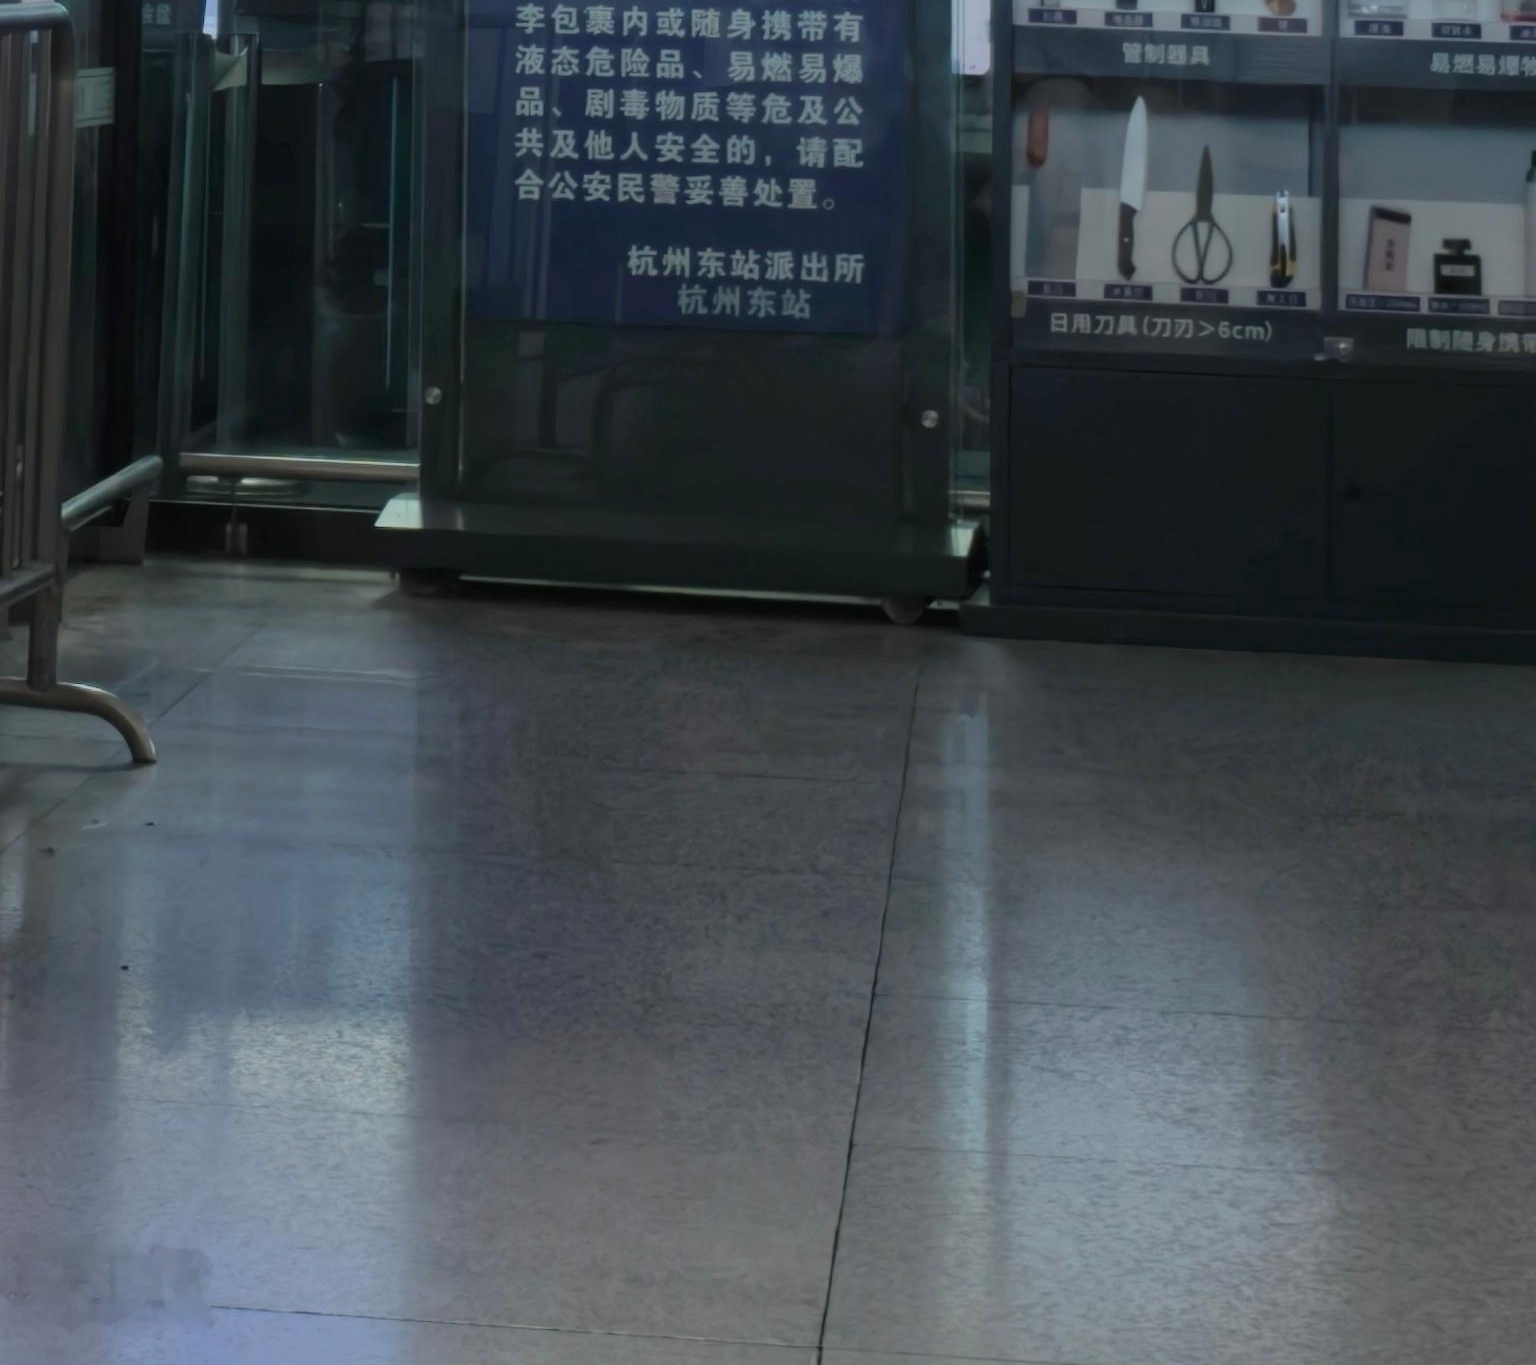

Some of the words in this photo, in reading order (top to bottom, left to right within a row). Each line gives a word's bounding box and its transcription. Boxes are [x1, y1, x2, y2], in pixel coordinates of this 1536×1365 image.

[516, 4, 864, 42] 李包裹内或随身携带有
[628, 245, 864, 284] 杭州东站派出所
[679, 285, 810, 319] 杭州东站
